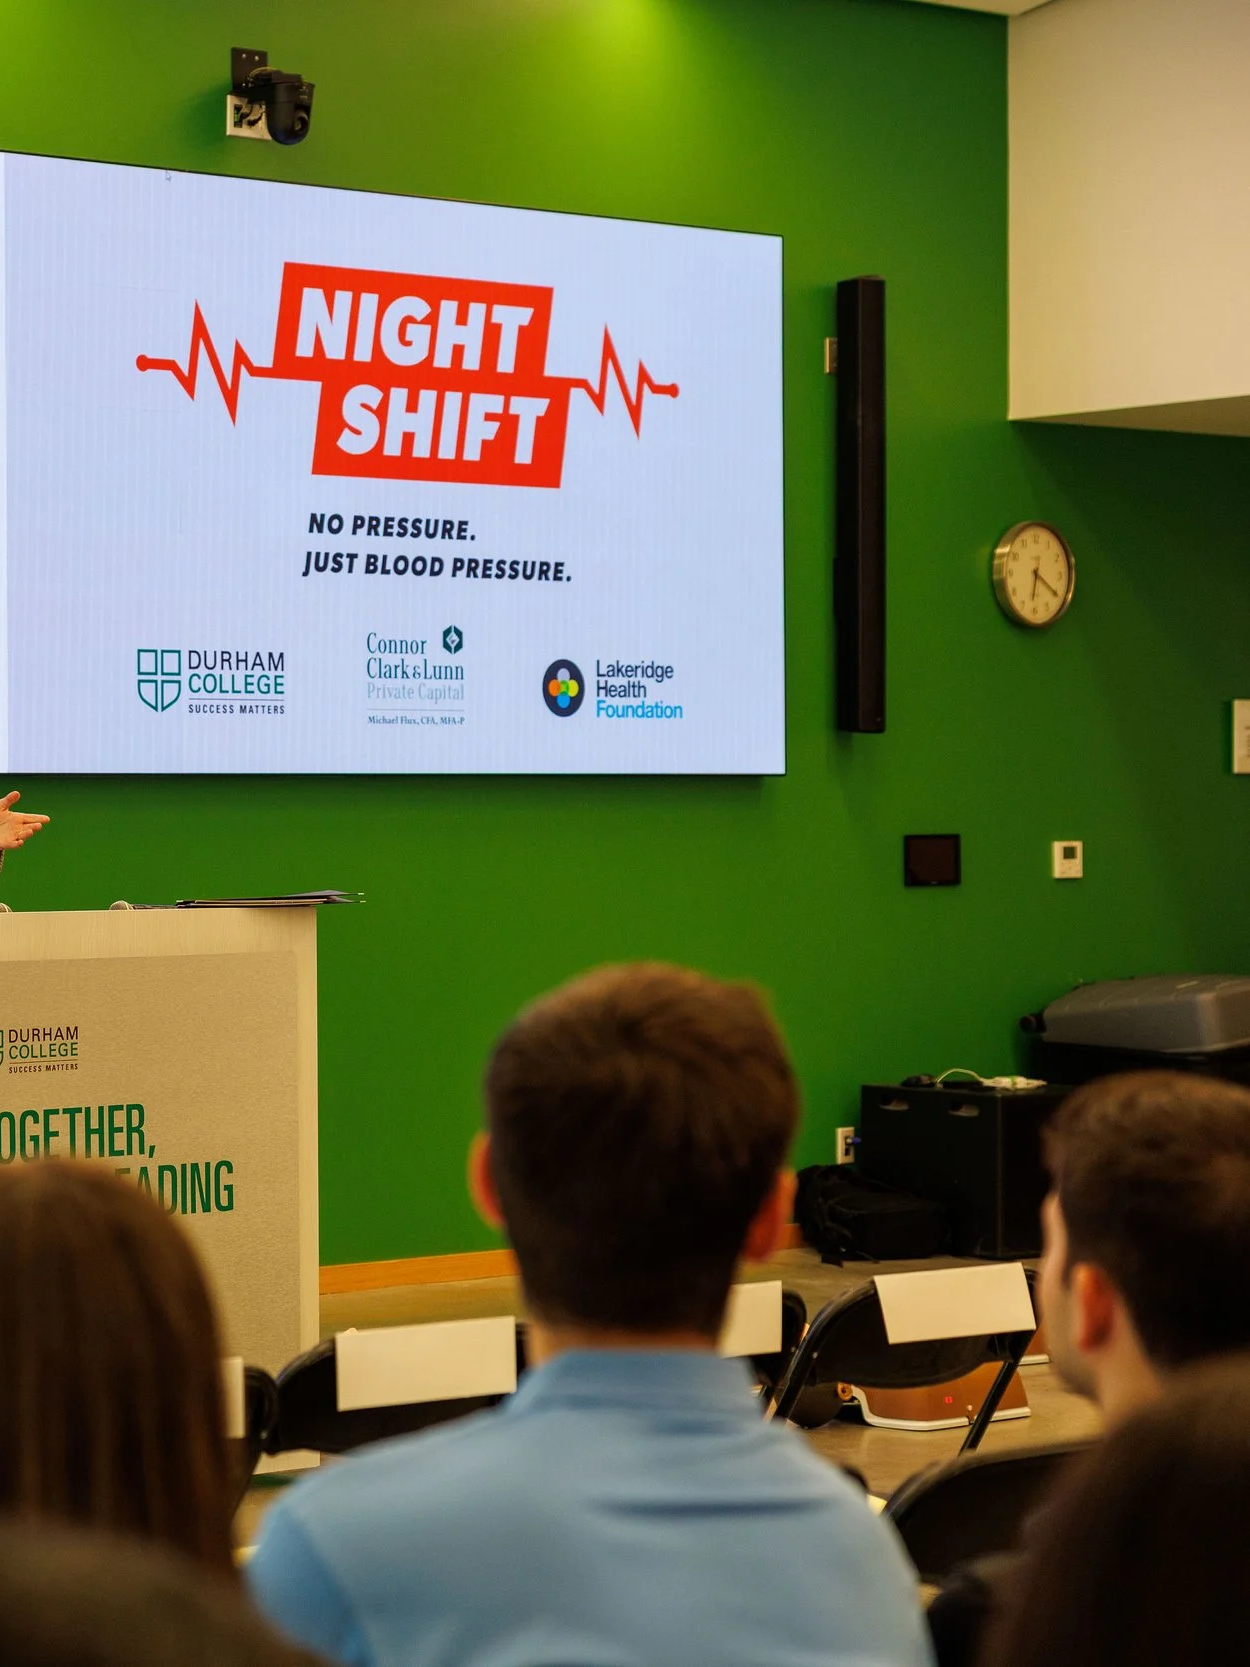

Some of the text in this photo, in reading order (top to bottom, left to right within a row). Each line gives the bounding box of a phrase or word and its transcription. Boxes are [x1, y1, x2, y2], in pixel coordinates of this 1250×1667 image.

[295, 287, 535, 373] NIGHT
[337, 385, 550, 464] SHIFT
[309, 513, 475, 541] NO PRESSURE.
[302, 552, 571, 582] JUST BLOOD PRESSURE.
[366, 632, 426, 654] Connor
[188, 650, 285, 671] DURHAM
[596, 660, 674, 683] Lakeridge
[189, 673, 284, 694] COLLEGE
[367, 681, 464, 704] Private Capital
[597, 680, 646, 698] Health
[189, 704, 284, 714] SUCCESS MATTERS
[597, 700, 683, 718] Foundation
[368, 715, 398, 725] Michael
[9, 1026, 78, 1043] DURHAM
[9, 1042, 78, 1059] COLLEGE
[9, 1063, 78, 1074] SUCCESS MATTERS
